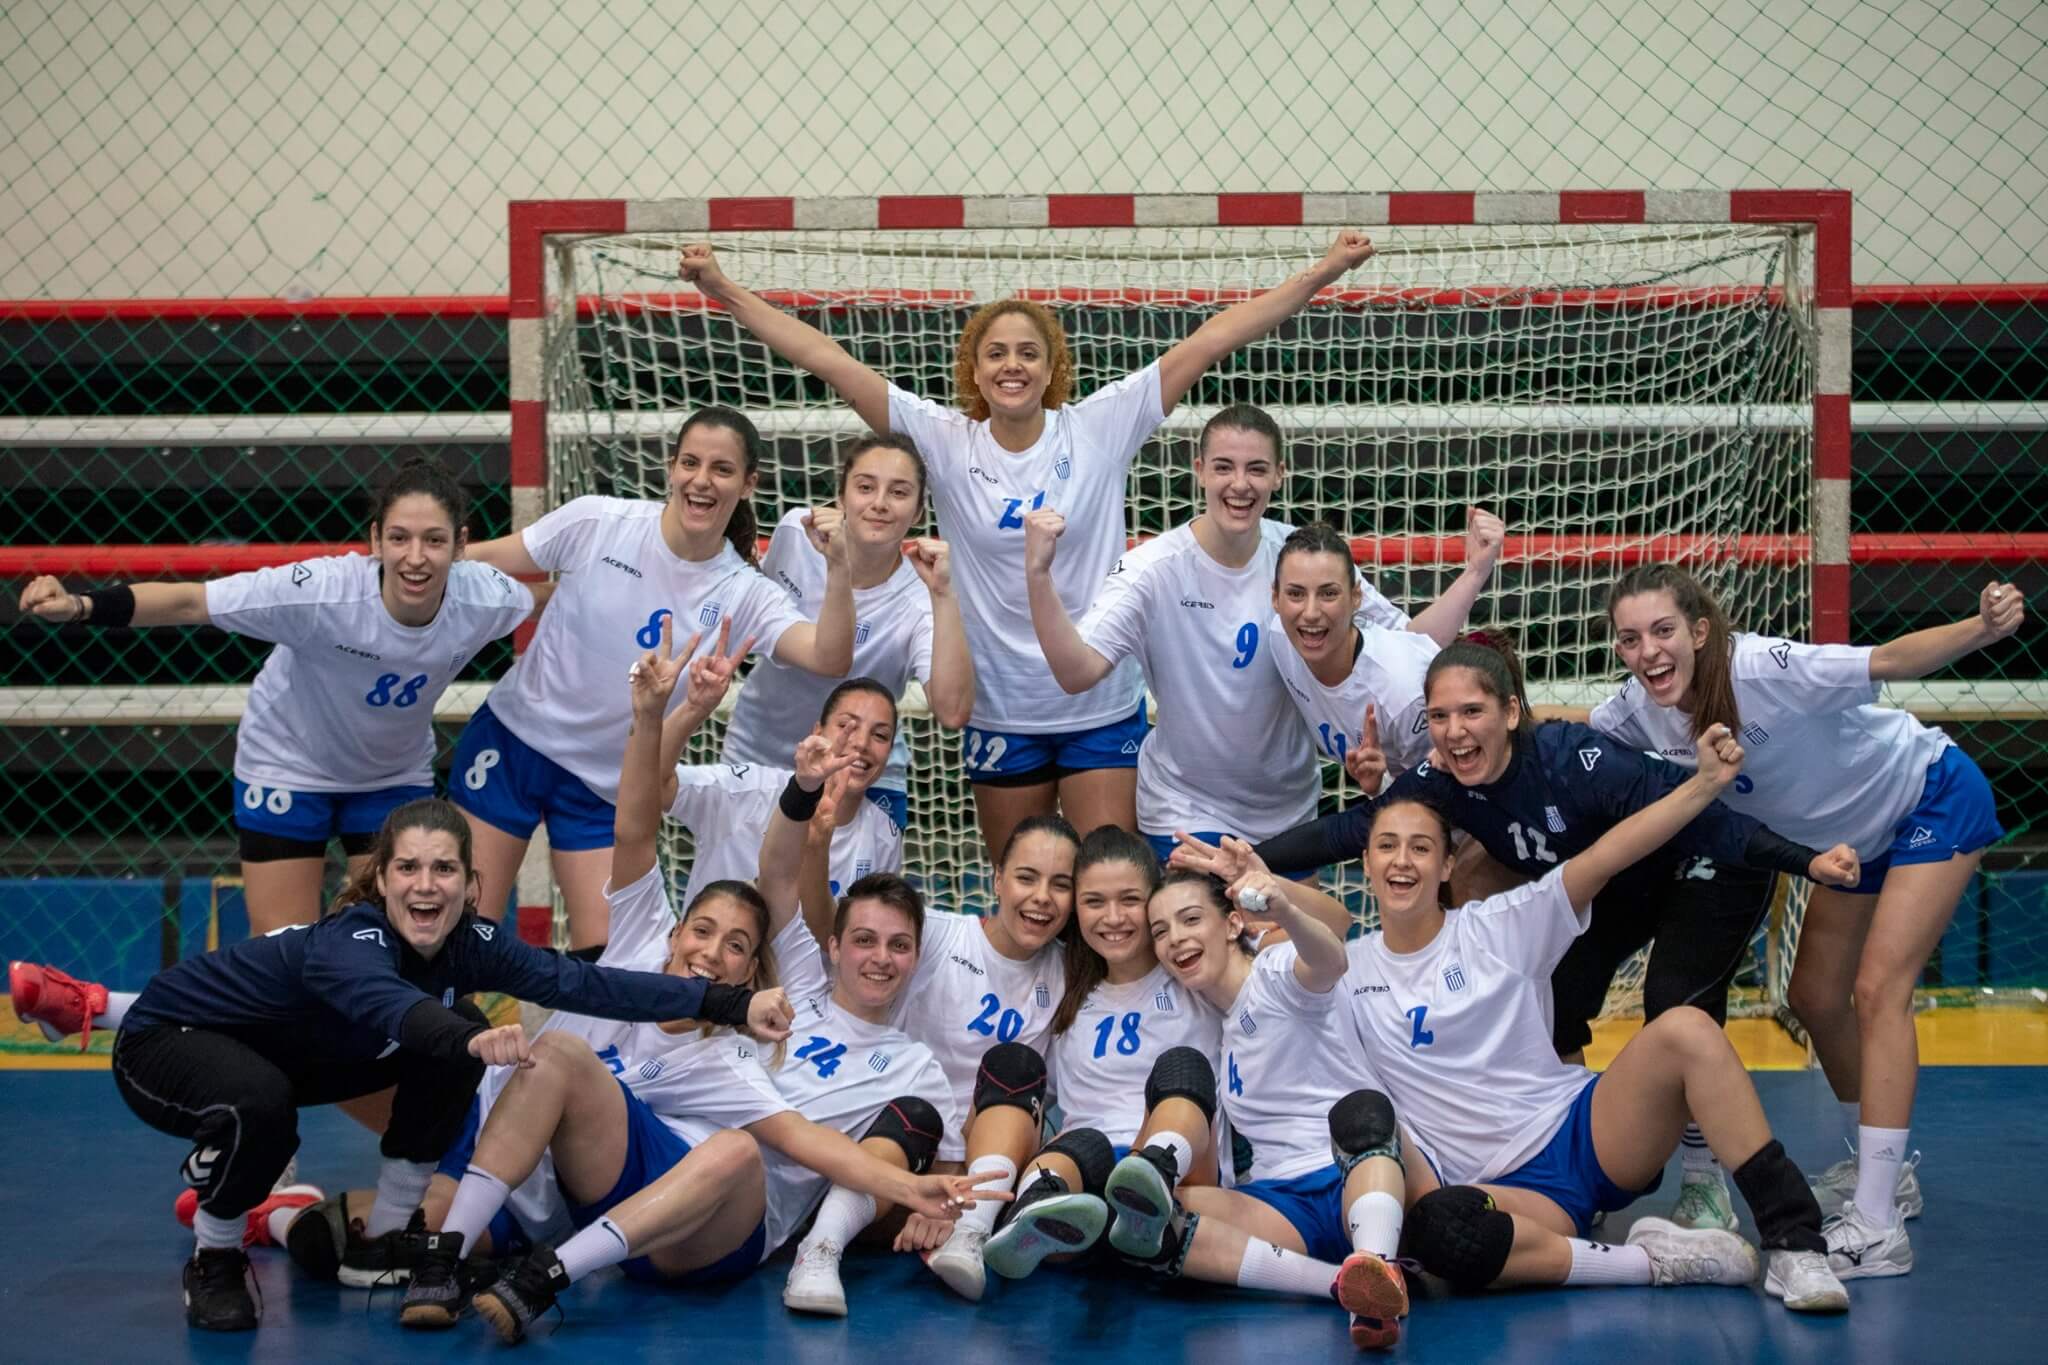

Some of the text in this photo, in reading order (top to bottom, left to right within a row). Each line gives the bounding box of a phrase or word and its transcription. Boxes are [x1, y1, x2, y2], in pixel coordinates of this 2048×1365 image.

[636, 608, 673, 650] 8
[1232, 622, 1259, 669] 9
[365, 673, 429, 708] 88
[465, 749, 501, 790] 8
[966, 731, 1008, 772] 22
[1507, 821, 1558, 863] 12
[967, 993, 1025, 1043] 20
[1092, 1012, 1142, 1060] 18
[1405, 1005, 1434, 1049] 2
[793, 1035, 848, 1079] 14
[1228, 1051, 1244, 1098] 4
